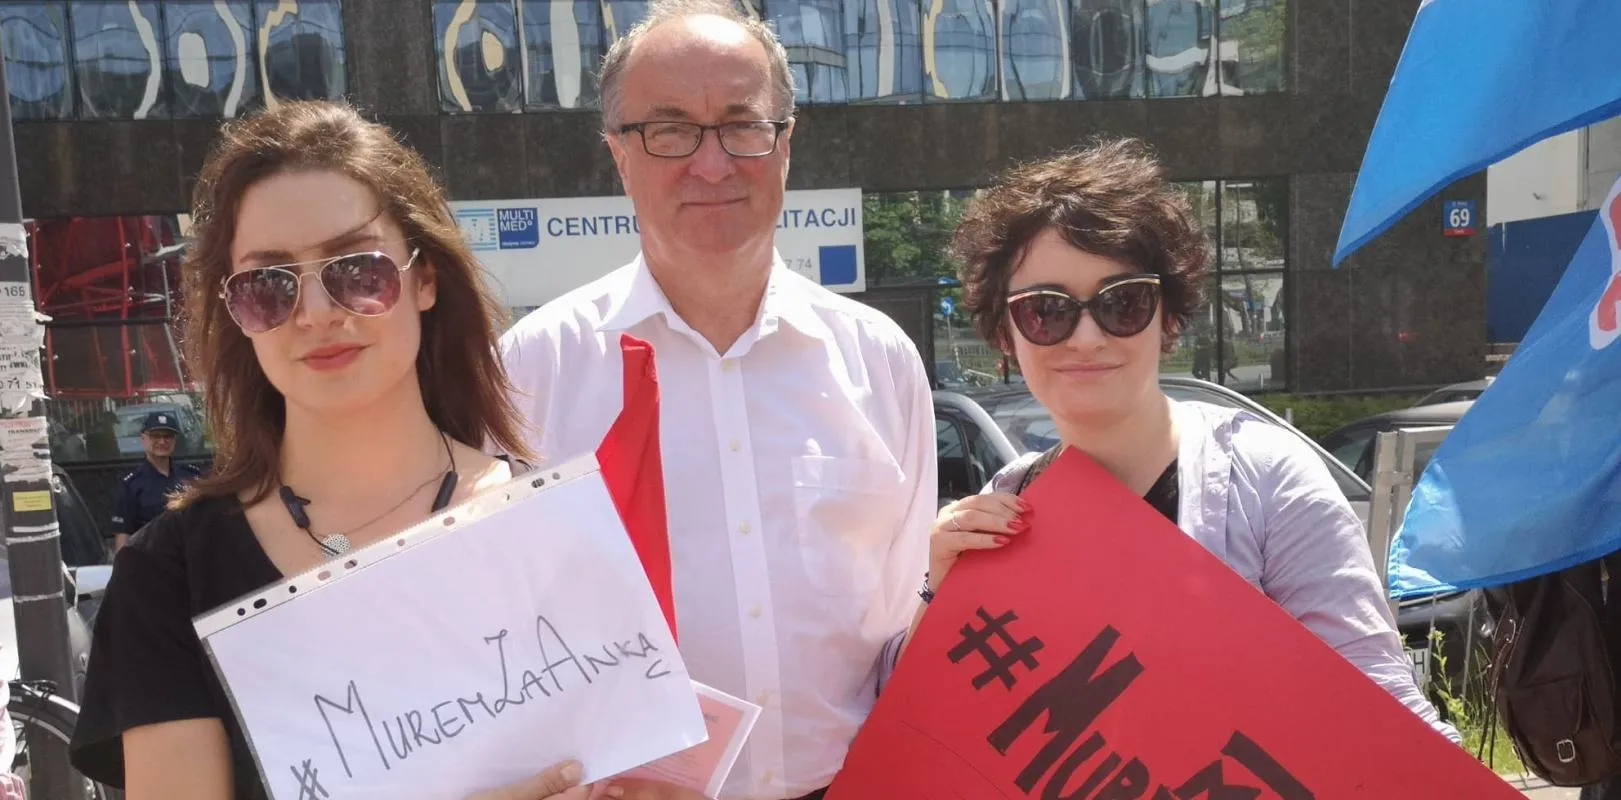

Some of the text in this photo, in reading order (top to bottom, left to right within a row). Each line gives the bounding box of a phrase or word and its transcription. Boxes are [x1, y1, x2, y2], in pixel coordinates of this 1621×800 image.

[499, 209, 534, 220] MULTI
[1449, 208, 1470, 227] 69
[4, 286, 26, 297] 165
